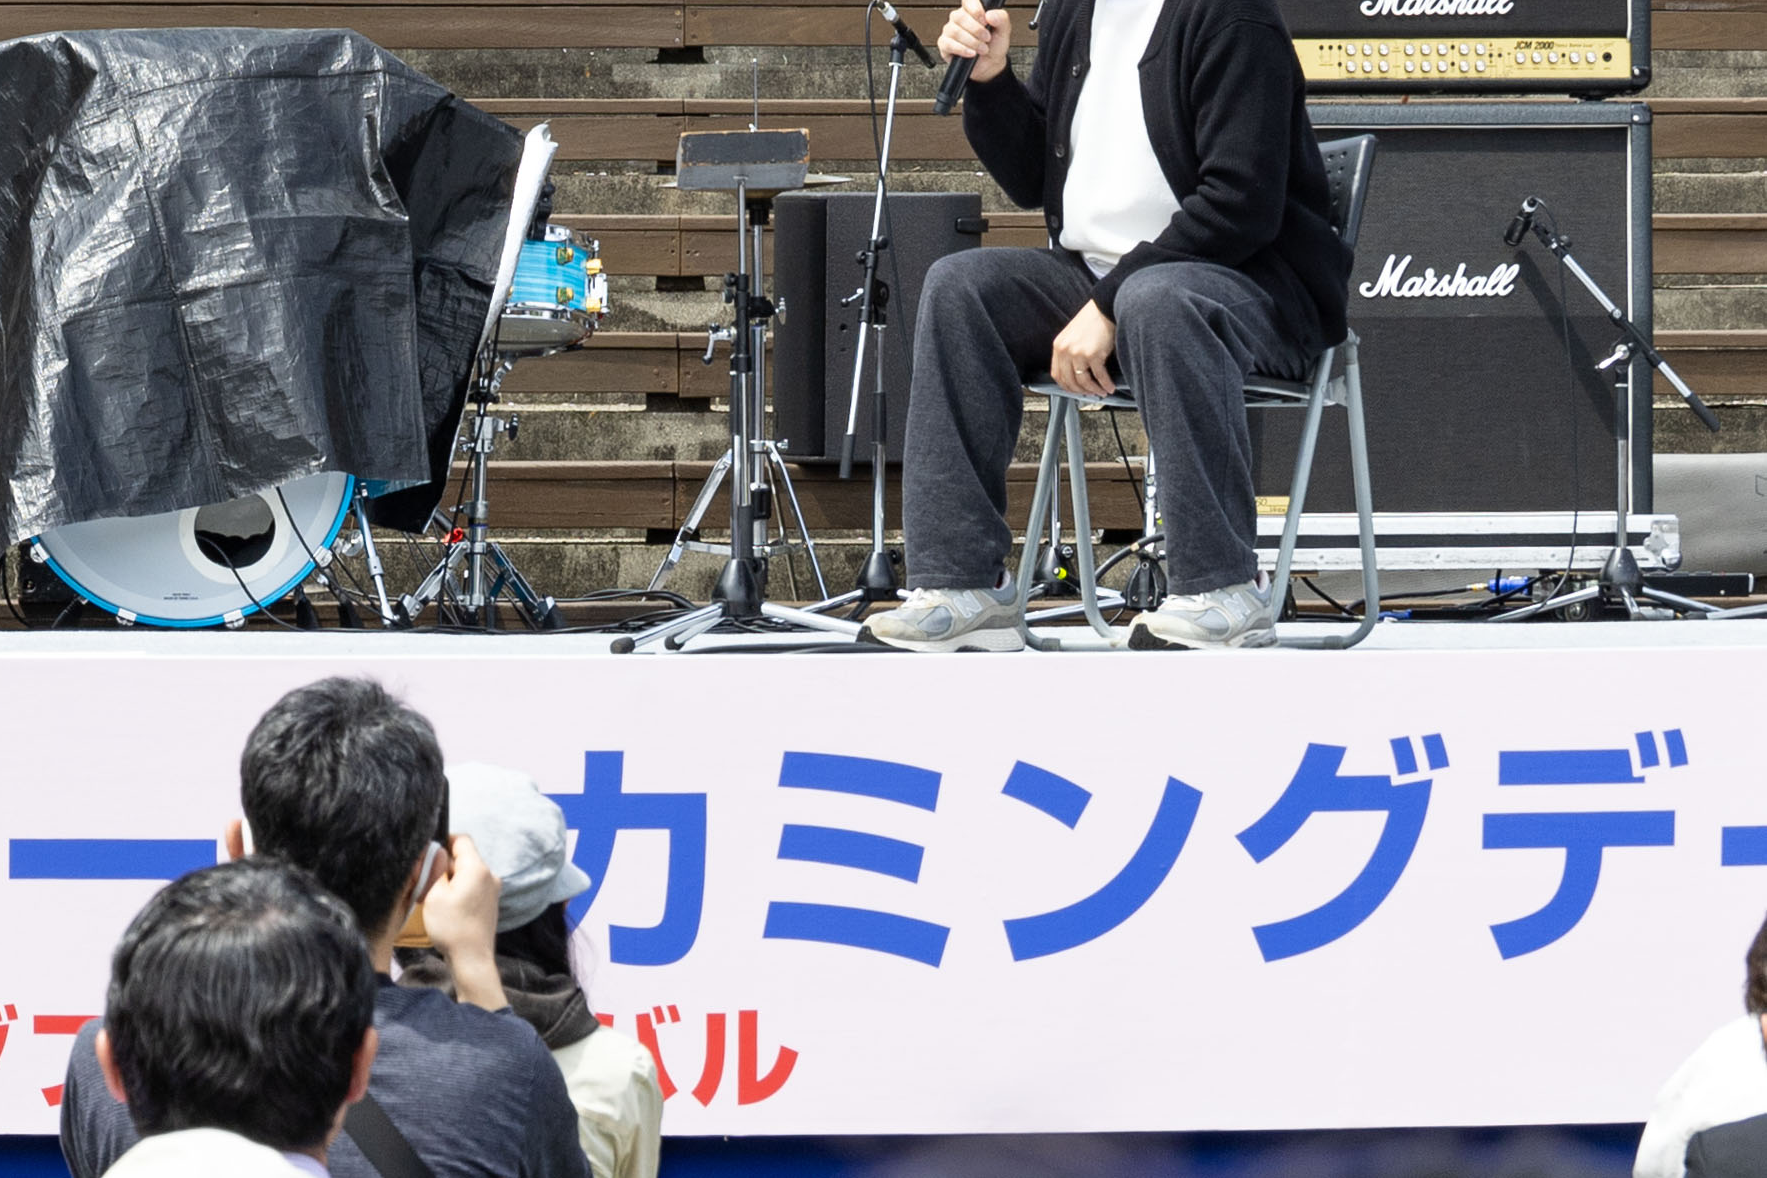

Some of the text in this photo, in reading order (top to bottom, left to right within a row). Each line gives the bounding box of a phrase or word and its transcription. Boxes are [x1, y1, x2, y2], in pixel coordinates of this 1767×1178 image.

[1513, 40, 1532, 50] JCM
[1533, 40, 1555, 51] 2000
[1359, 254, 1521, 298] Marshall
